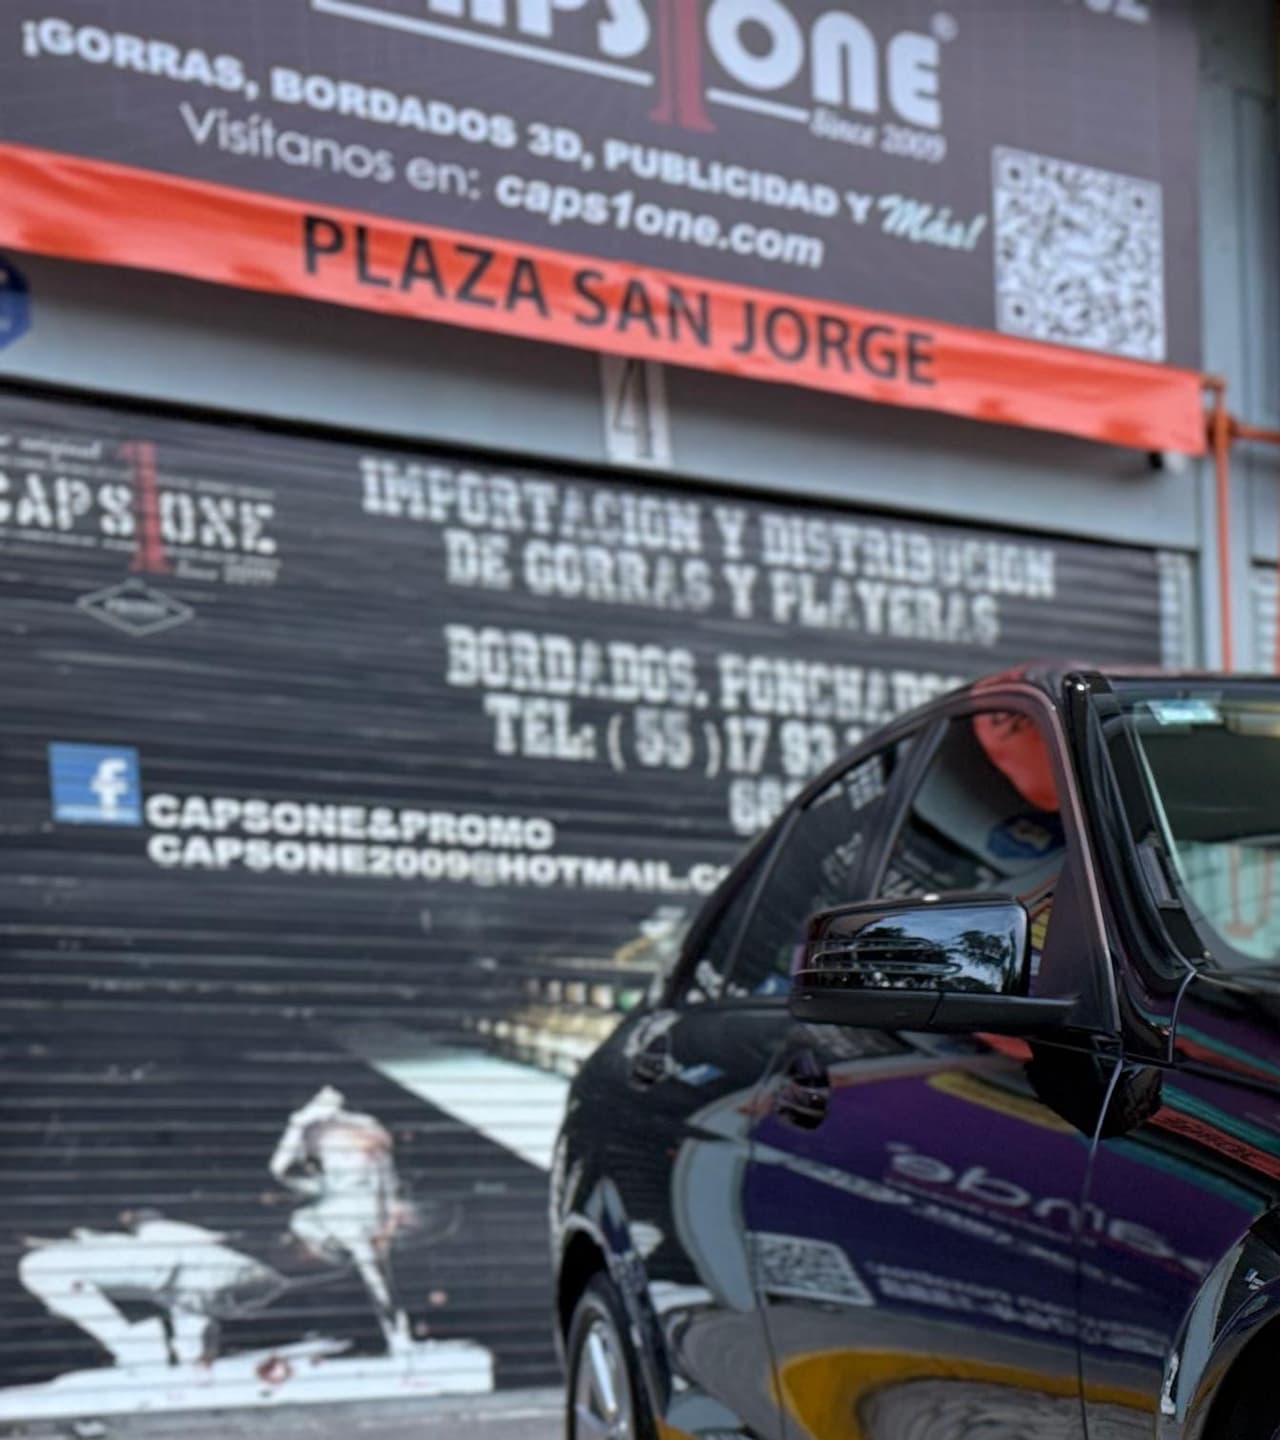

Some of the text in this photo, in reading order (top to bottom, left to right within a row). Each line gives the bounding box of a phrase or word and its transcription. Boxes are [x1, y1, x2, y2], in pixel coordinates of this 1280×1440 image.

[22, 19, 259, 100] ¡GORRAS,
[270, 66, 517, 149] BORDADOS
[527, 122, 596, 171] 3D,
[604, 139, 839, 217] PUBLICIDAD
[846, 196, 876, 224] Y
[180, 101, 825, 269] Visítanos en: caps1one.com
[300, 213, 938, 386] PLAZA SAN JORGE
[360, 457, 1057, 598] IMPORTACION Y DISTRIBUCION
[444, 528, 1003, 646] DE GORRAS Y PLAYERAS
[484, 692, 597, 761] TEL:
[718, 652, 967, 724] PONCHADO
[145, 794, 556, 850] CAPSONE&PROMO
